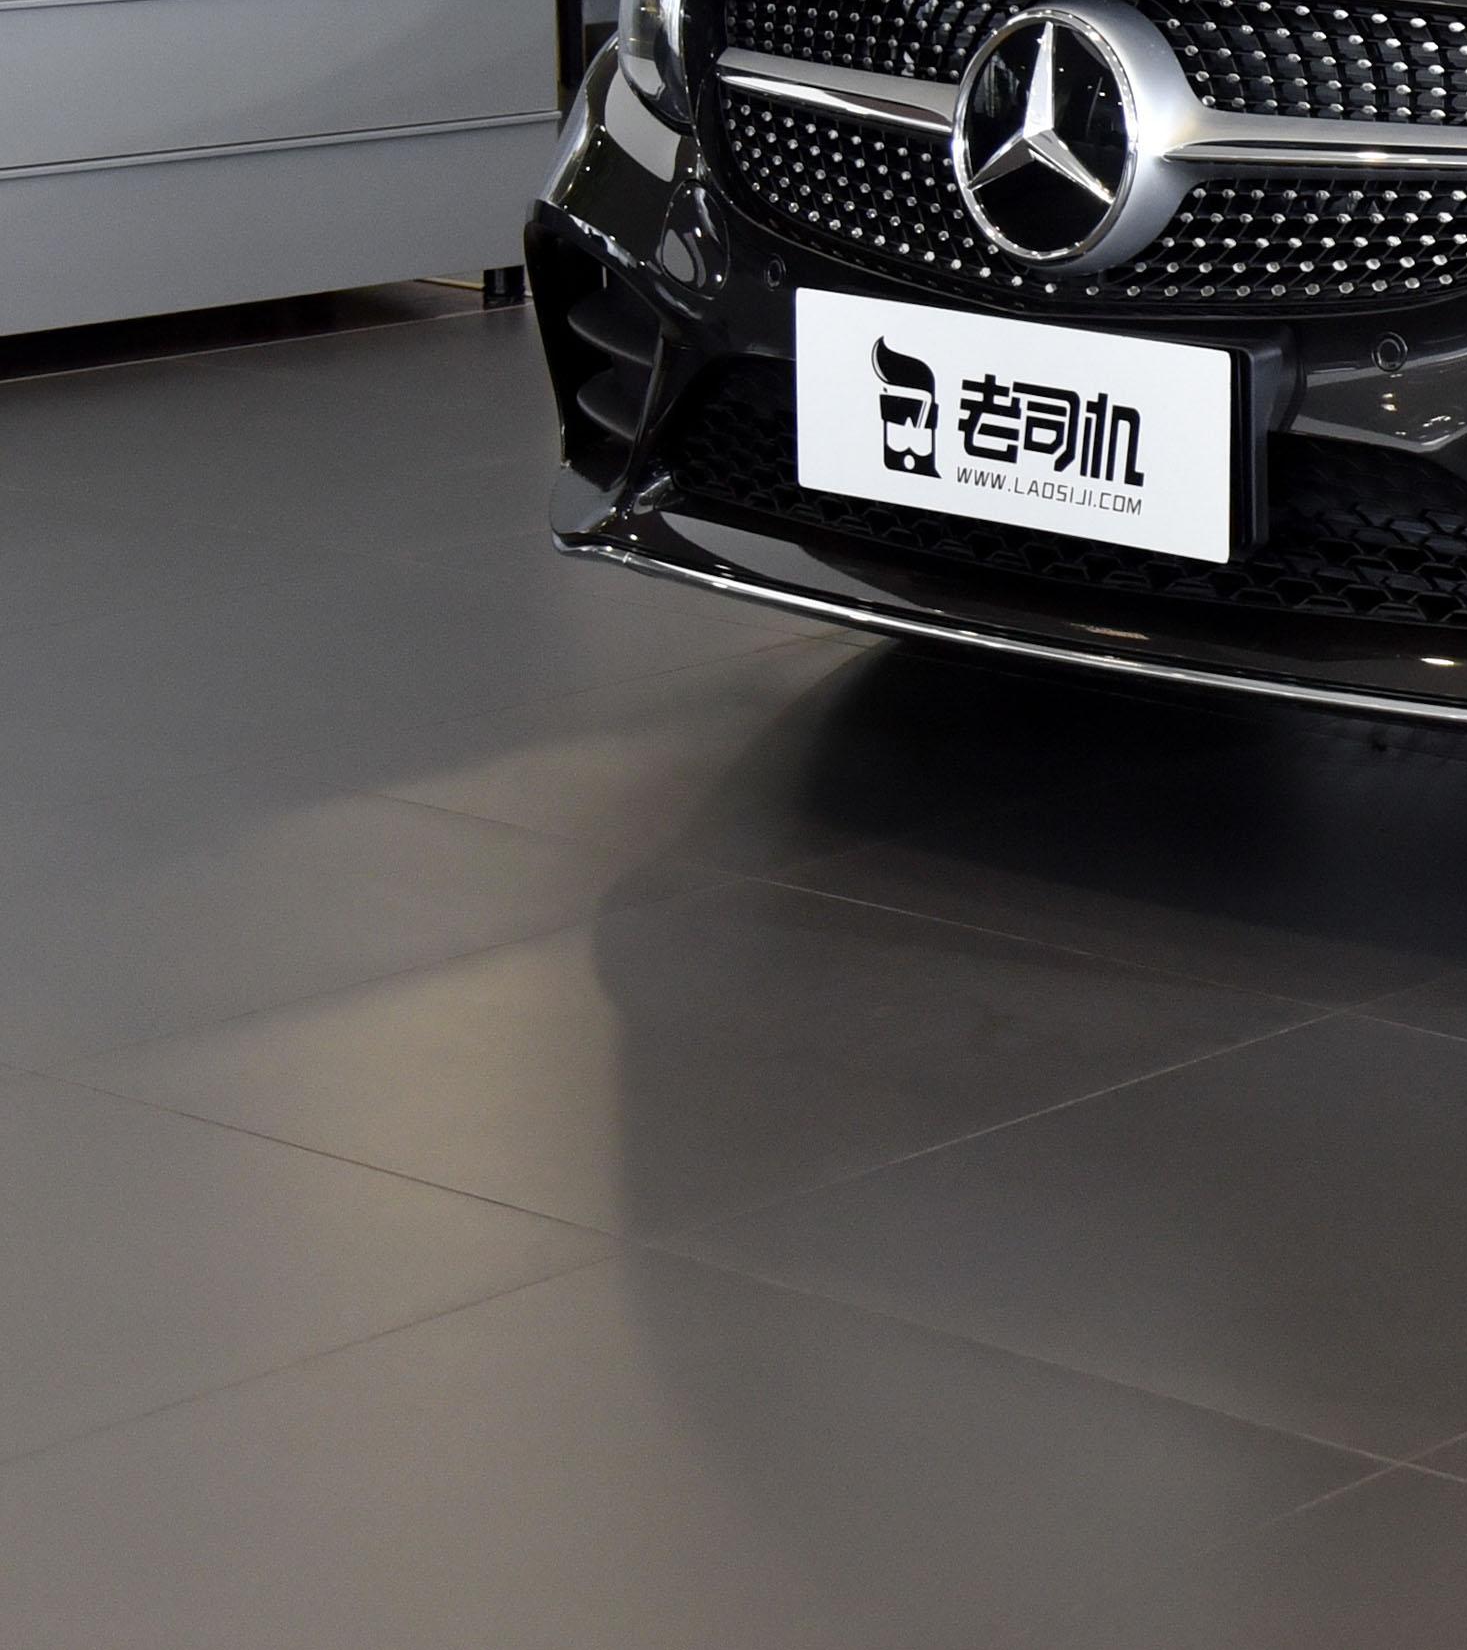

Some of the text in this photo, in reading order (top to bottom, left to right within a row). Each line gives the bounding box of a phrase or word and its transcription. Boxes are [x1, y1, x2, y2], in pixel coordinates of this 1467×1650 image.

[957, 373, 1145, 487] 老司机
[956, 466, 1143, 517] WWW.LAOSIJI.COM
